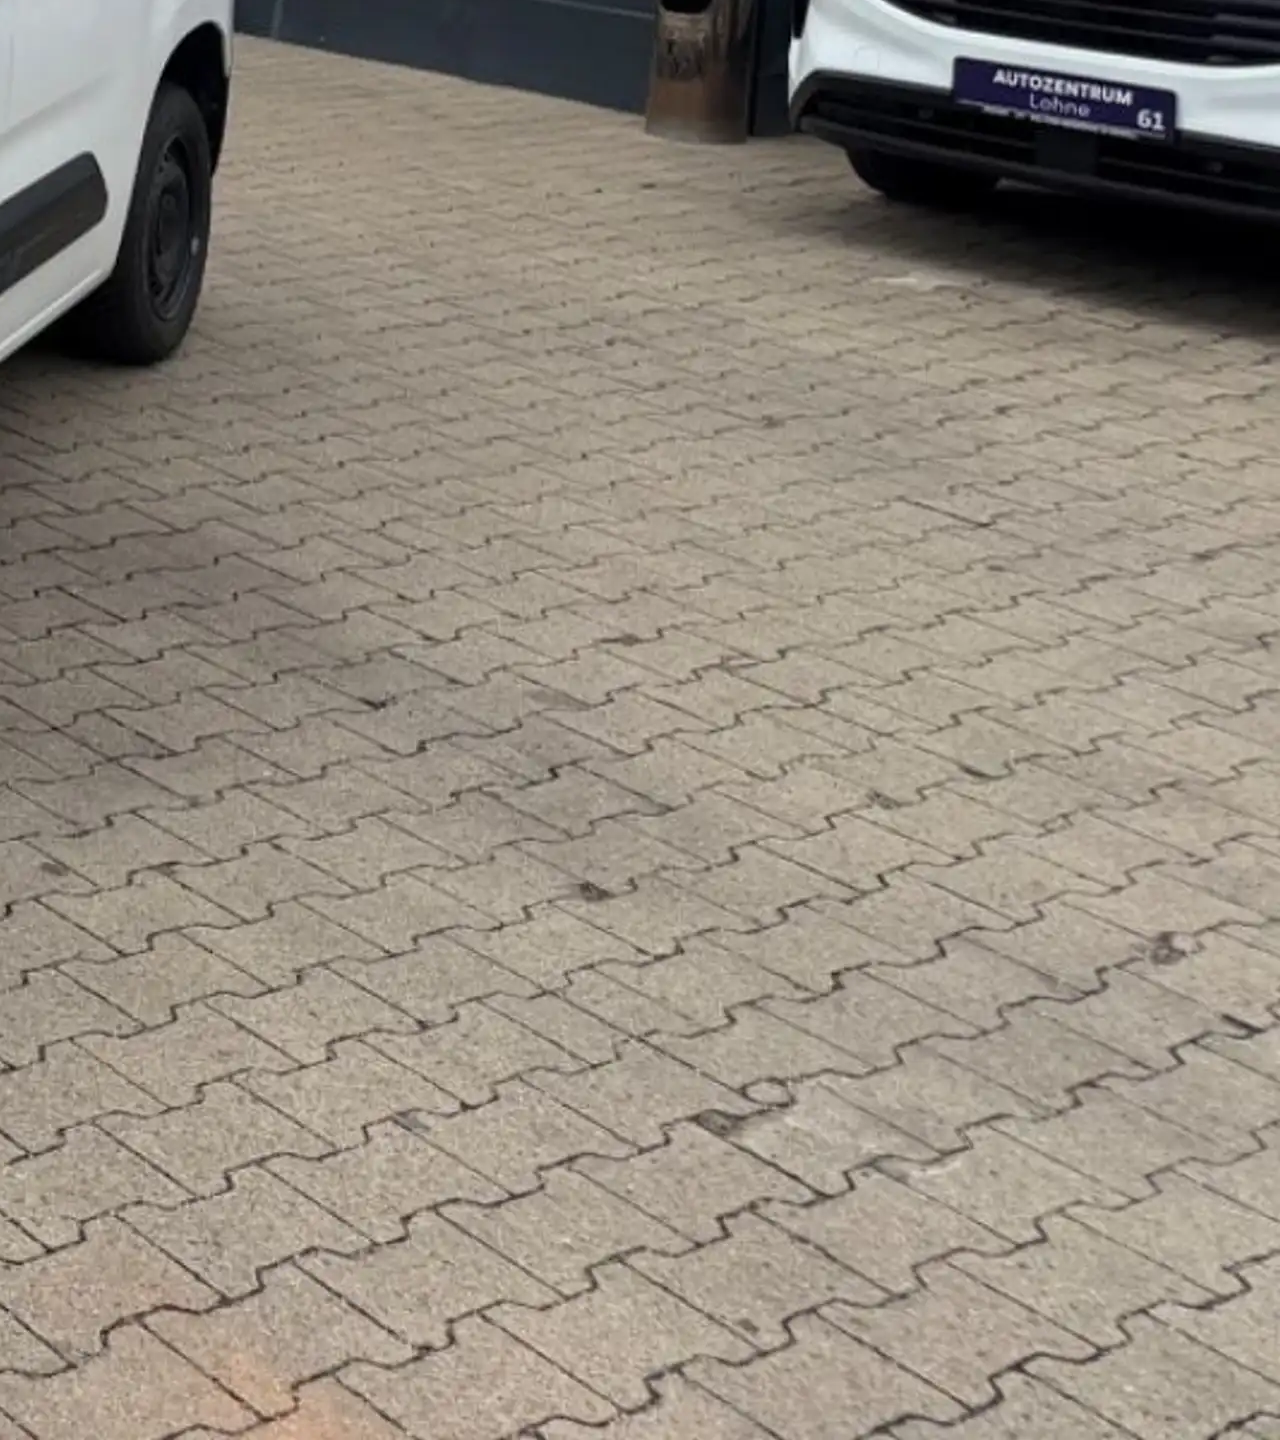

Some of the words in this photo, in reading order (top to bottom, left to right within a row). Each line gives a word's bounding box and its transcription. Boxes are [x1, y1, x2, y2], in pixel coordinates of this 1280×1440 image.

[992, 68, 1133, 106] AUTOZENTRUM
[1029, 93, 1090, 117] Lohne
[1136, 109, 1166, 131] 61
